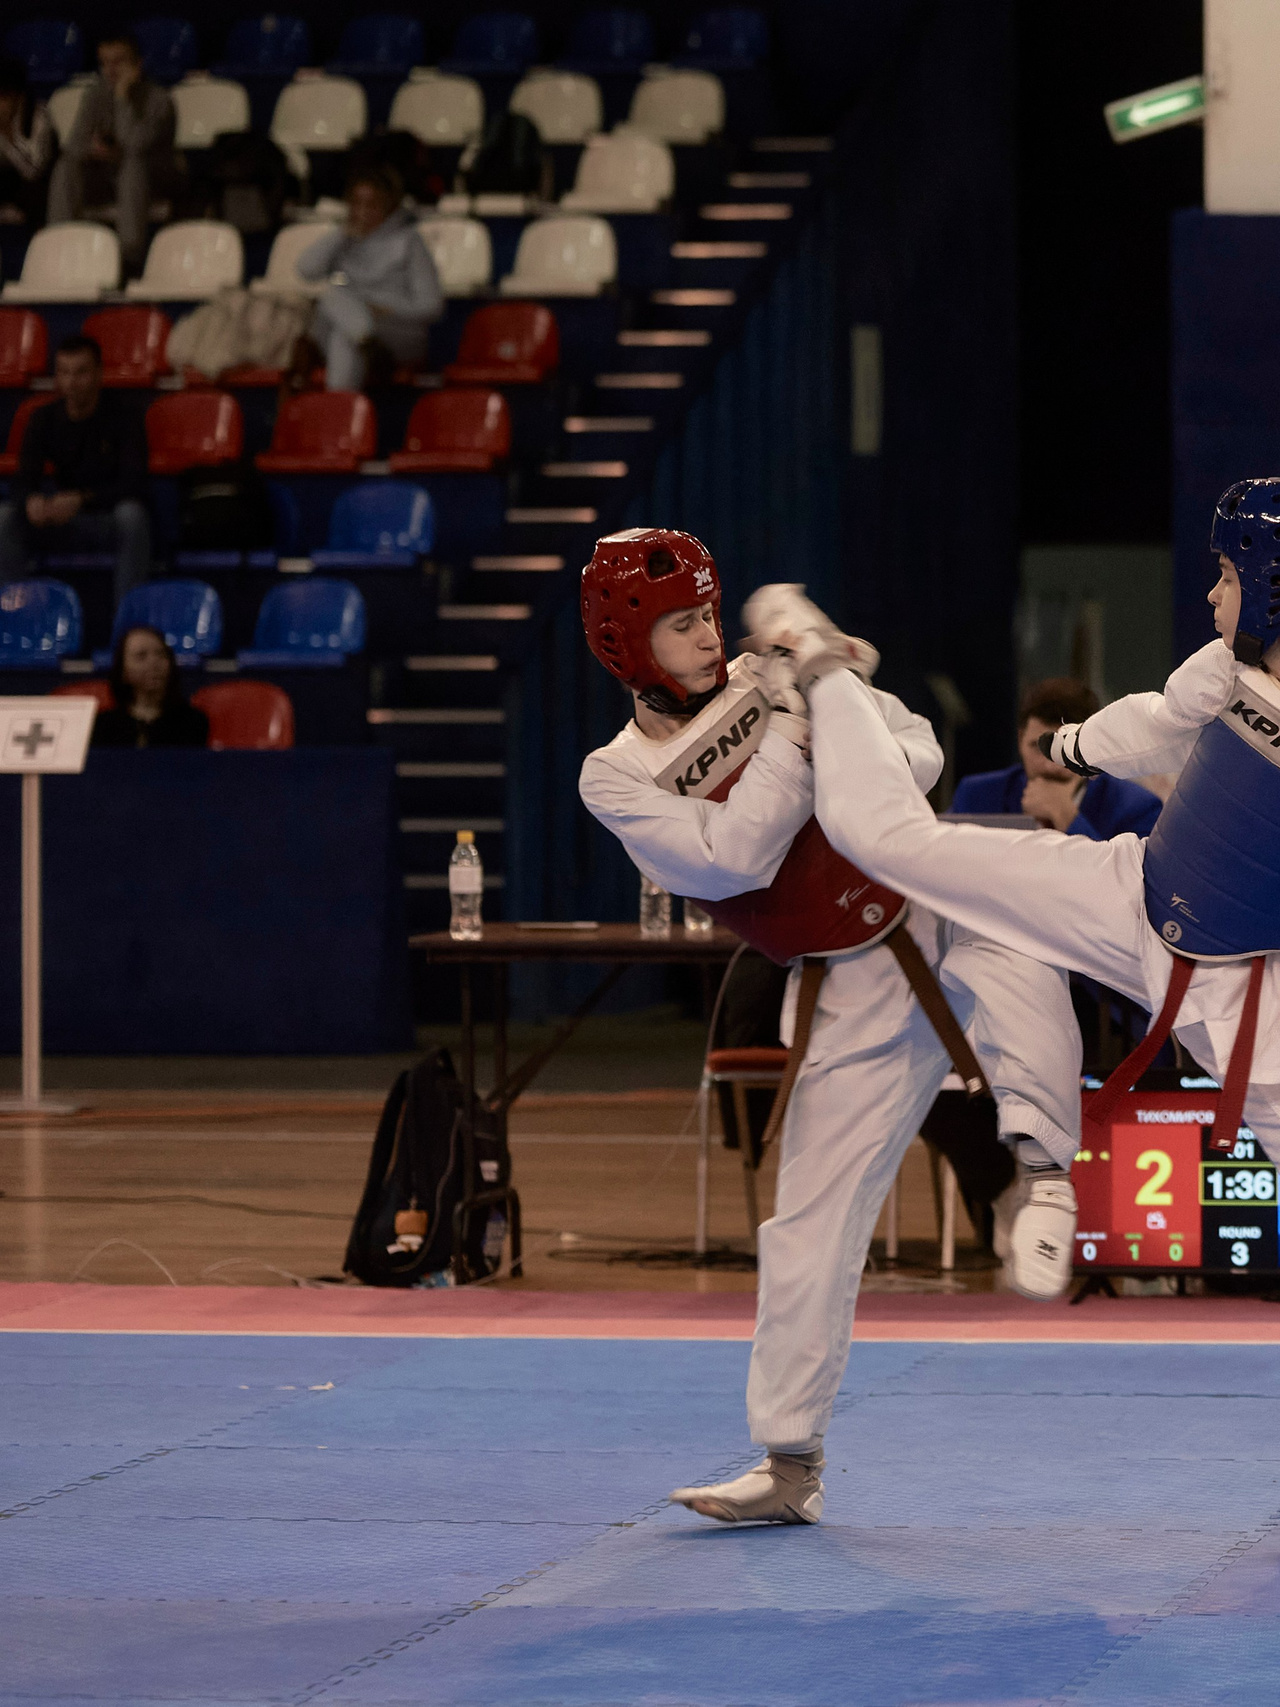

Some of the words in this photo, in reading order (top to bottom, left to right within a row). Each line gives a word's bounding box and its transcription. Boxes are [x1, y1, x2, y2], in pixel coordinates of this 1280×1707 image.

[674, 706, 760, 796] KPNP
[1166, 924, 1178, 938] 3
[1226, 1141, 1255, 1159] 01
[1134, 1149, 1173, 1206] 2
[1206, 1169, 1275, 1200] 1:36
[1218, 1226, 1262, 1239] ROUND
[1082, 1242, 1097, 1261] 0
[1128, 1242, 1140, 1261] 1
[1168, 1242, 1184, 1262] 0
[1230, 1241, 1250, 1267] 3
